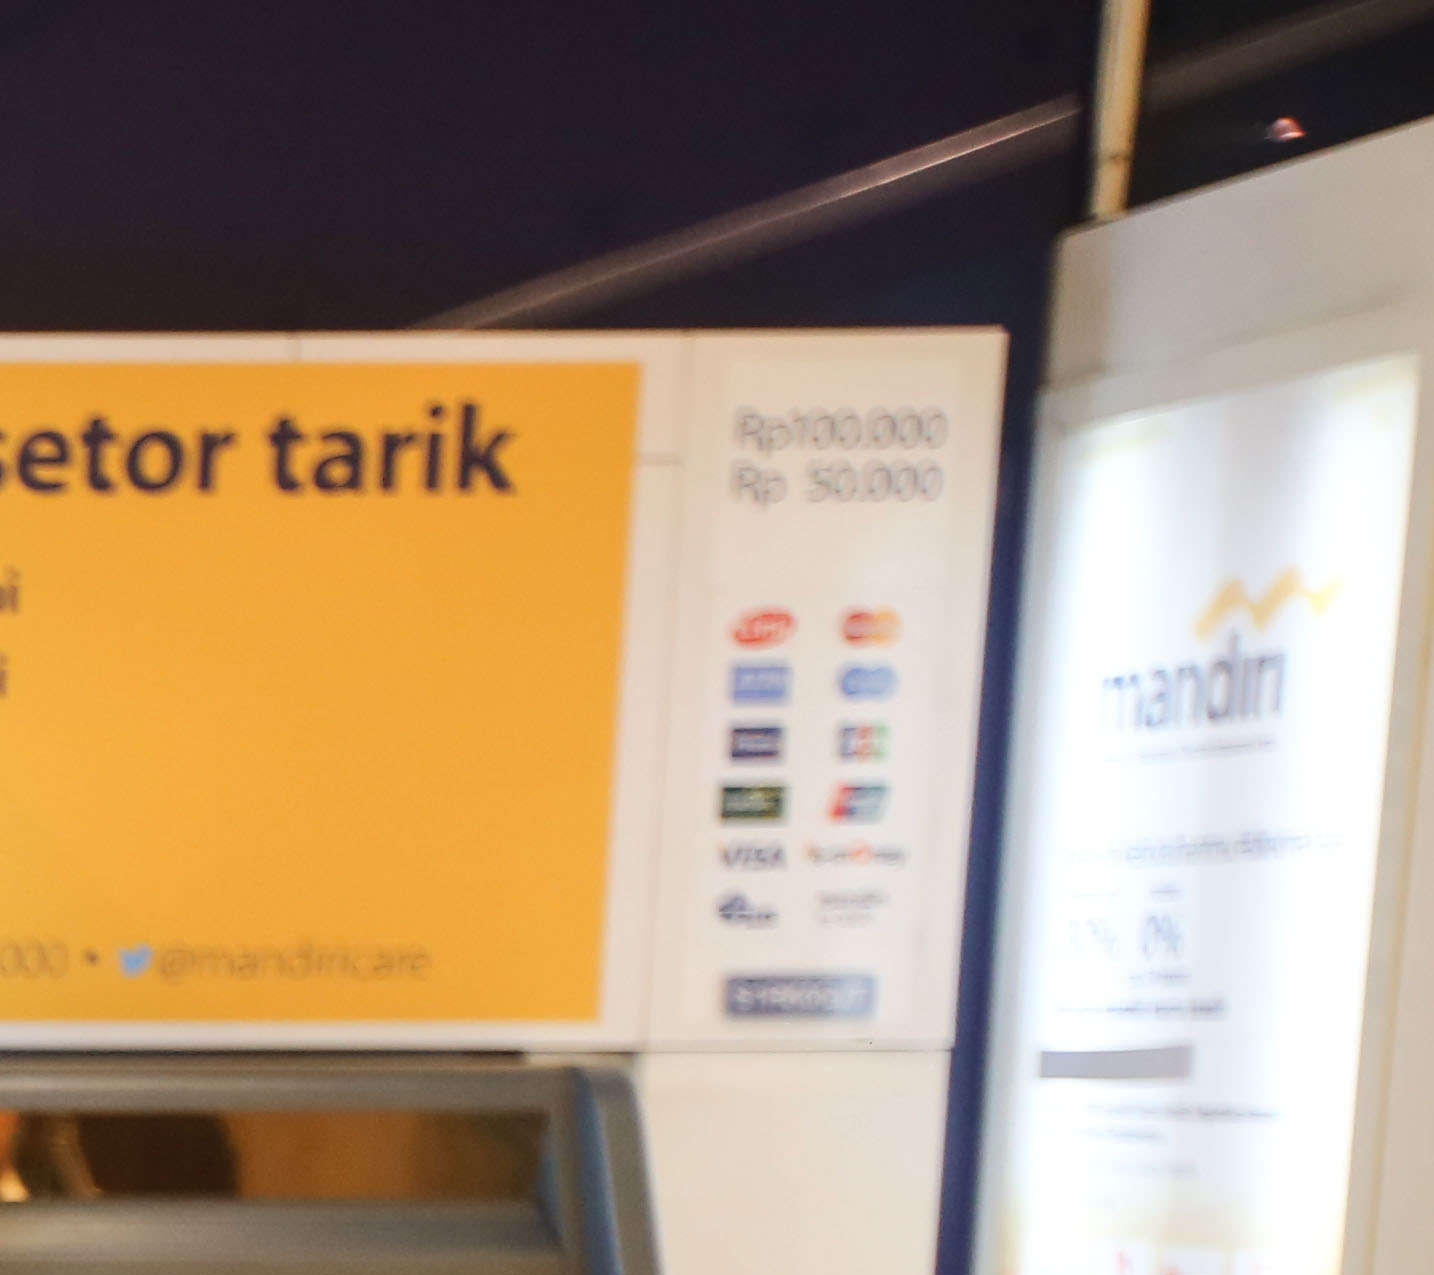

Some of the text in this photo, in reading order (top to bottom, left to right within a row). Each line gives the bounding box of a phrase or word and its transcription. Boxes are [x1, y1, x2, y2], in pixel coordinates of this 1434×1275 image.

[266, 402, 516, 495] tarik
[731, 459, 944, 508] Rp 50.000
